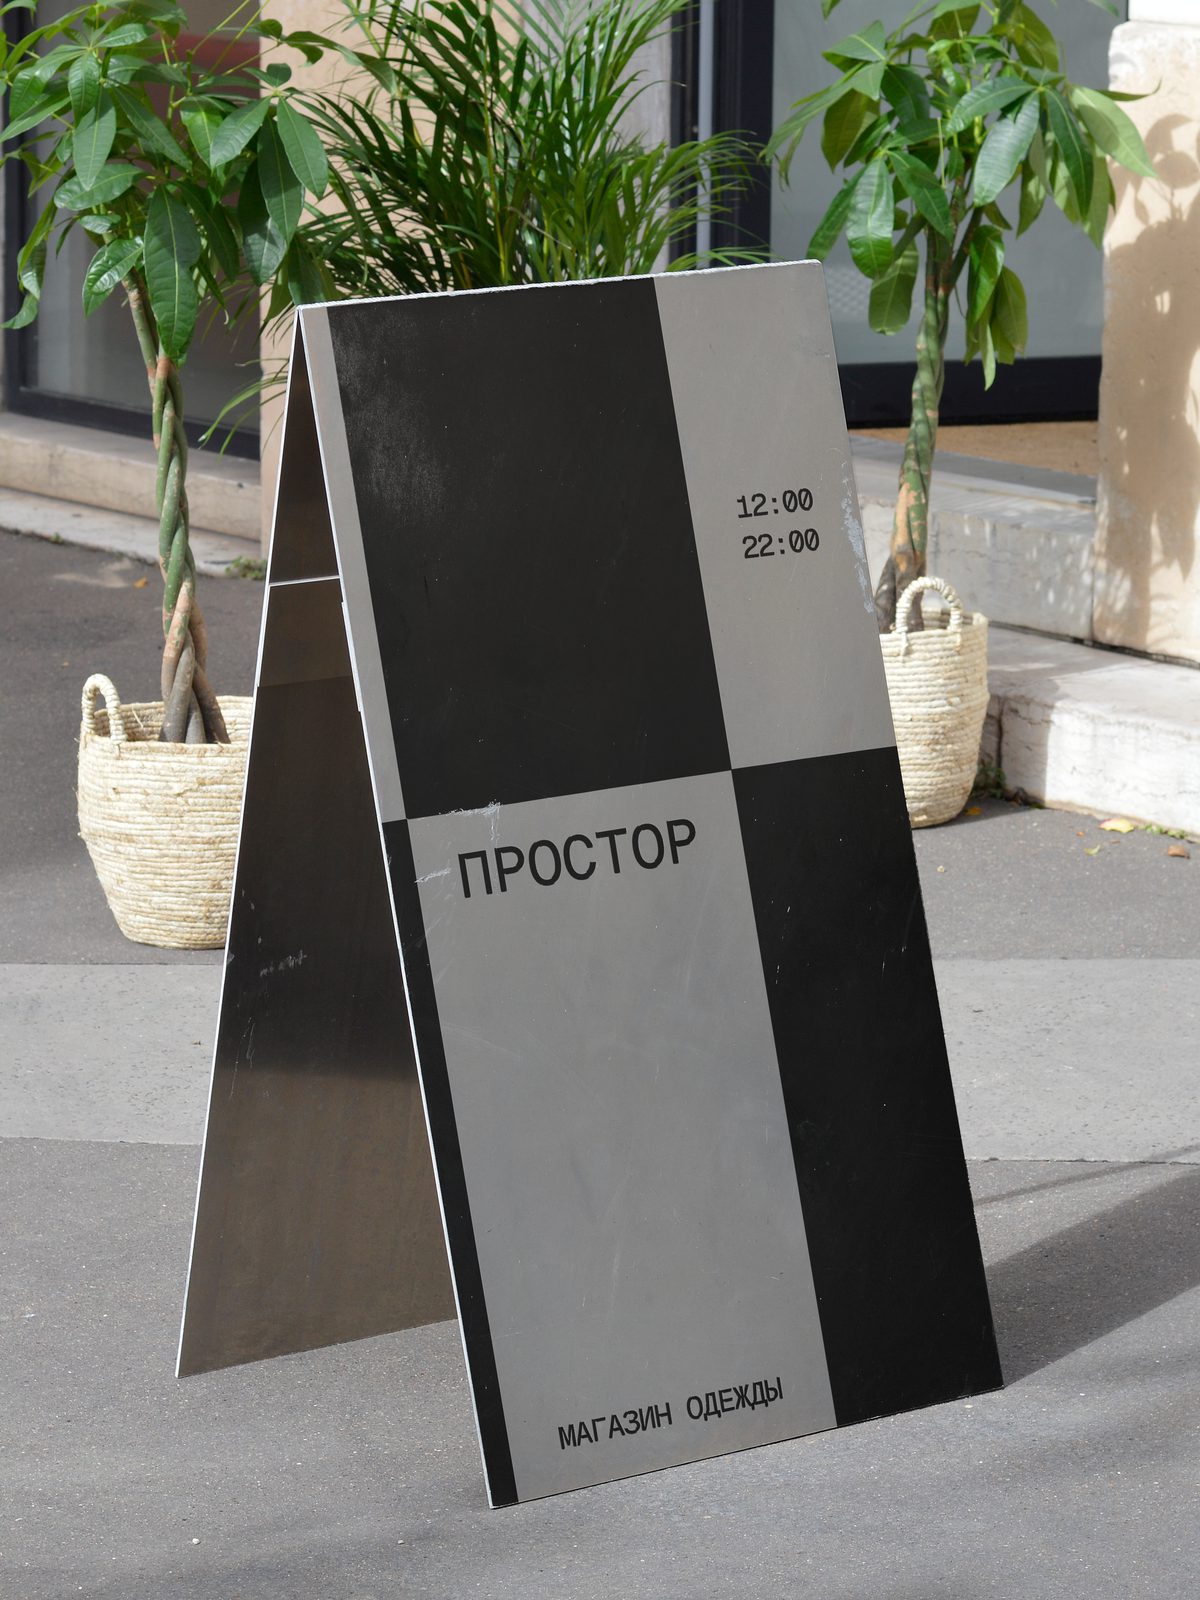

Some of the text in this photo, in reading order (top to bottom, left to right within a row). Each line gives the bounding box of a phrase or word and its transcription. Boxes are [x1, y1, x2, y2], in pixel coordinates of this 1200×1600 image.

[736, 487, 814, 519] 12:00
[742, 527, 820, 560] 22:00
[457, 817, 697, 899] ПРОСТОР
[557, 1376, 784, 1451] МАГАЗИН ОДЕЖДЫ
